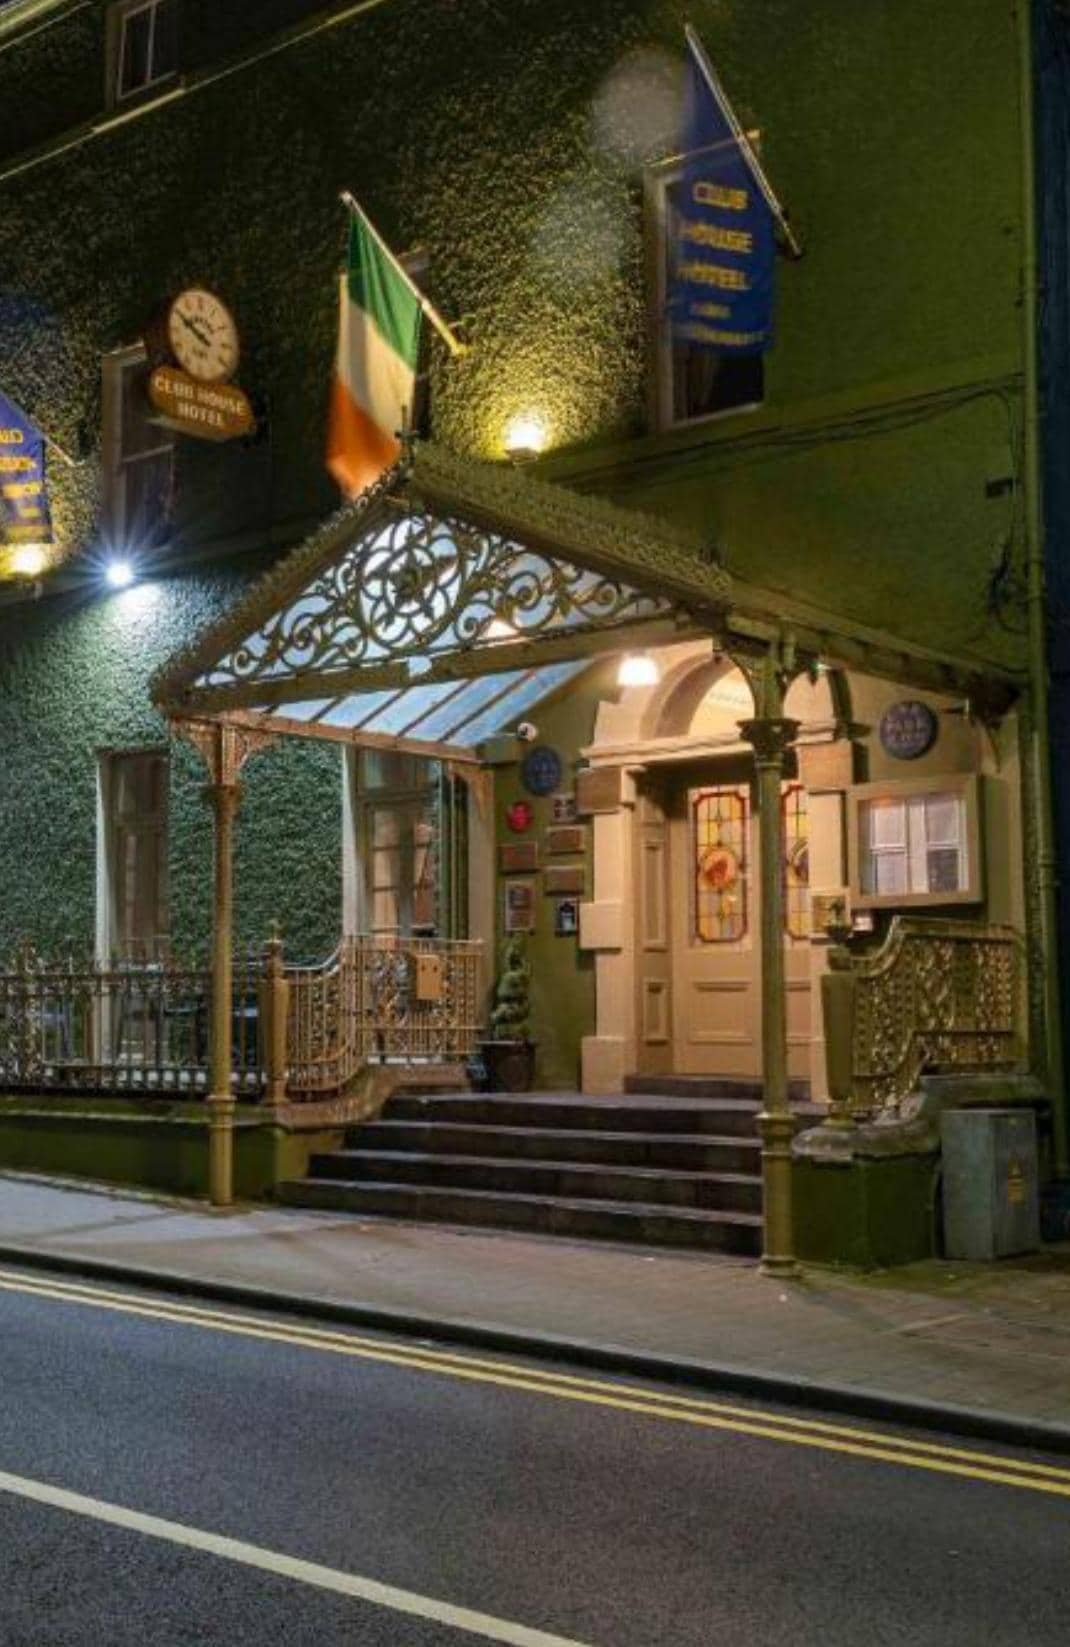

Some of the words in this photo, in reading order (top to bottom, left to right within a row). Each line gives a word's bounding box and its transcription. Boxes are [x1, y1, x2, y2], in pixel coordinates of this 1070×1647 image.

[154, 375, 195, 400] CLUB
[196, 388, 250, 418] HOUSE
[177, 402, 223, 427] HOTEL
